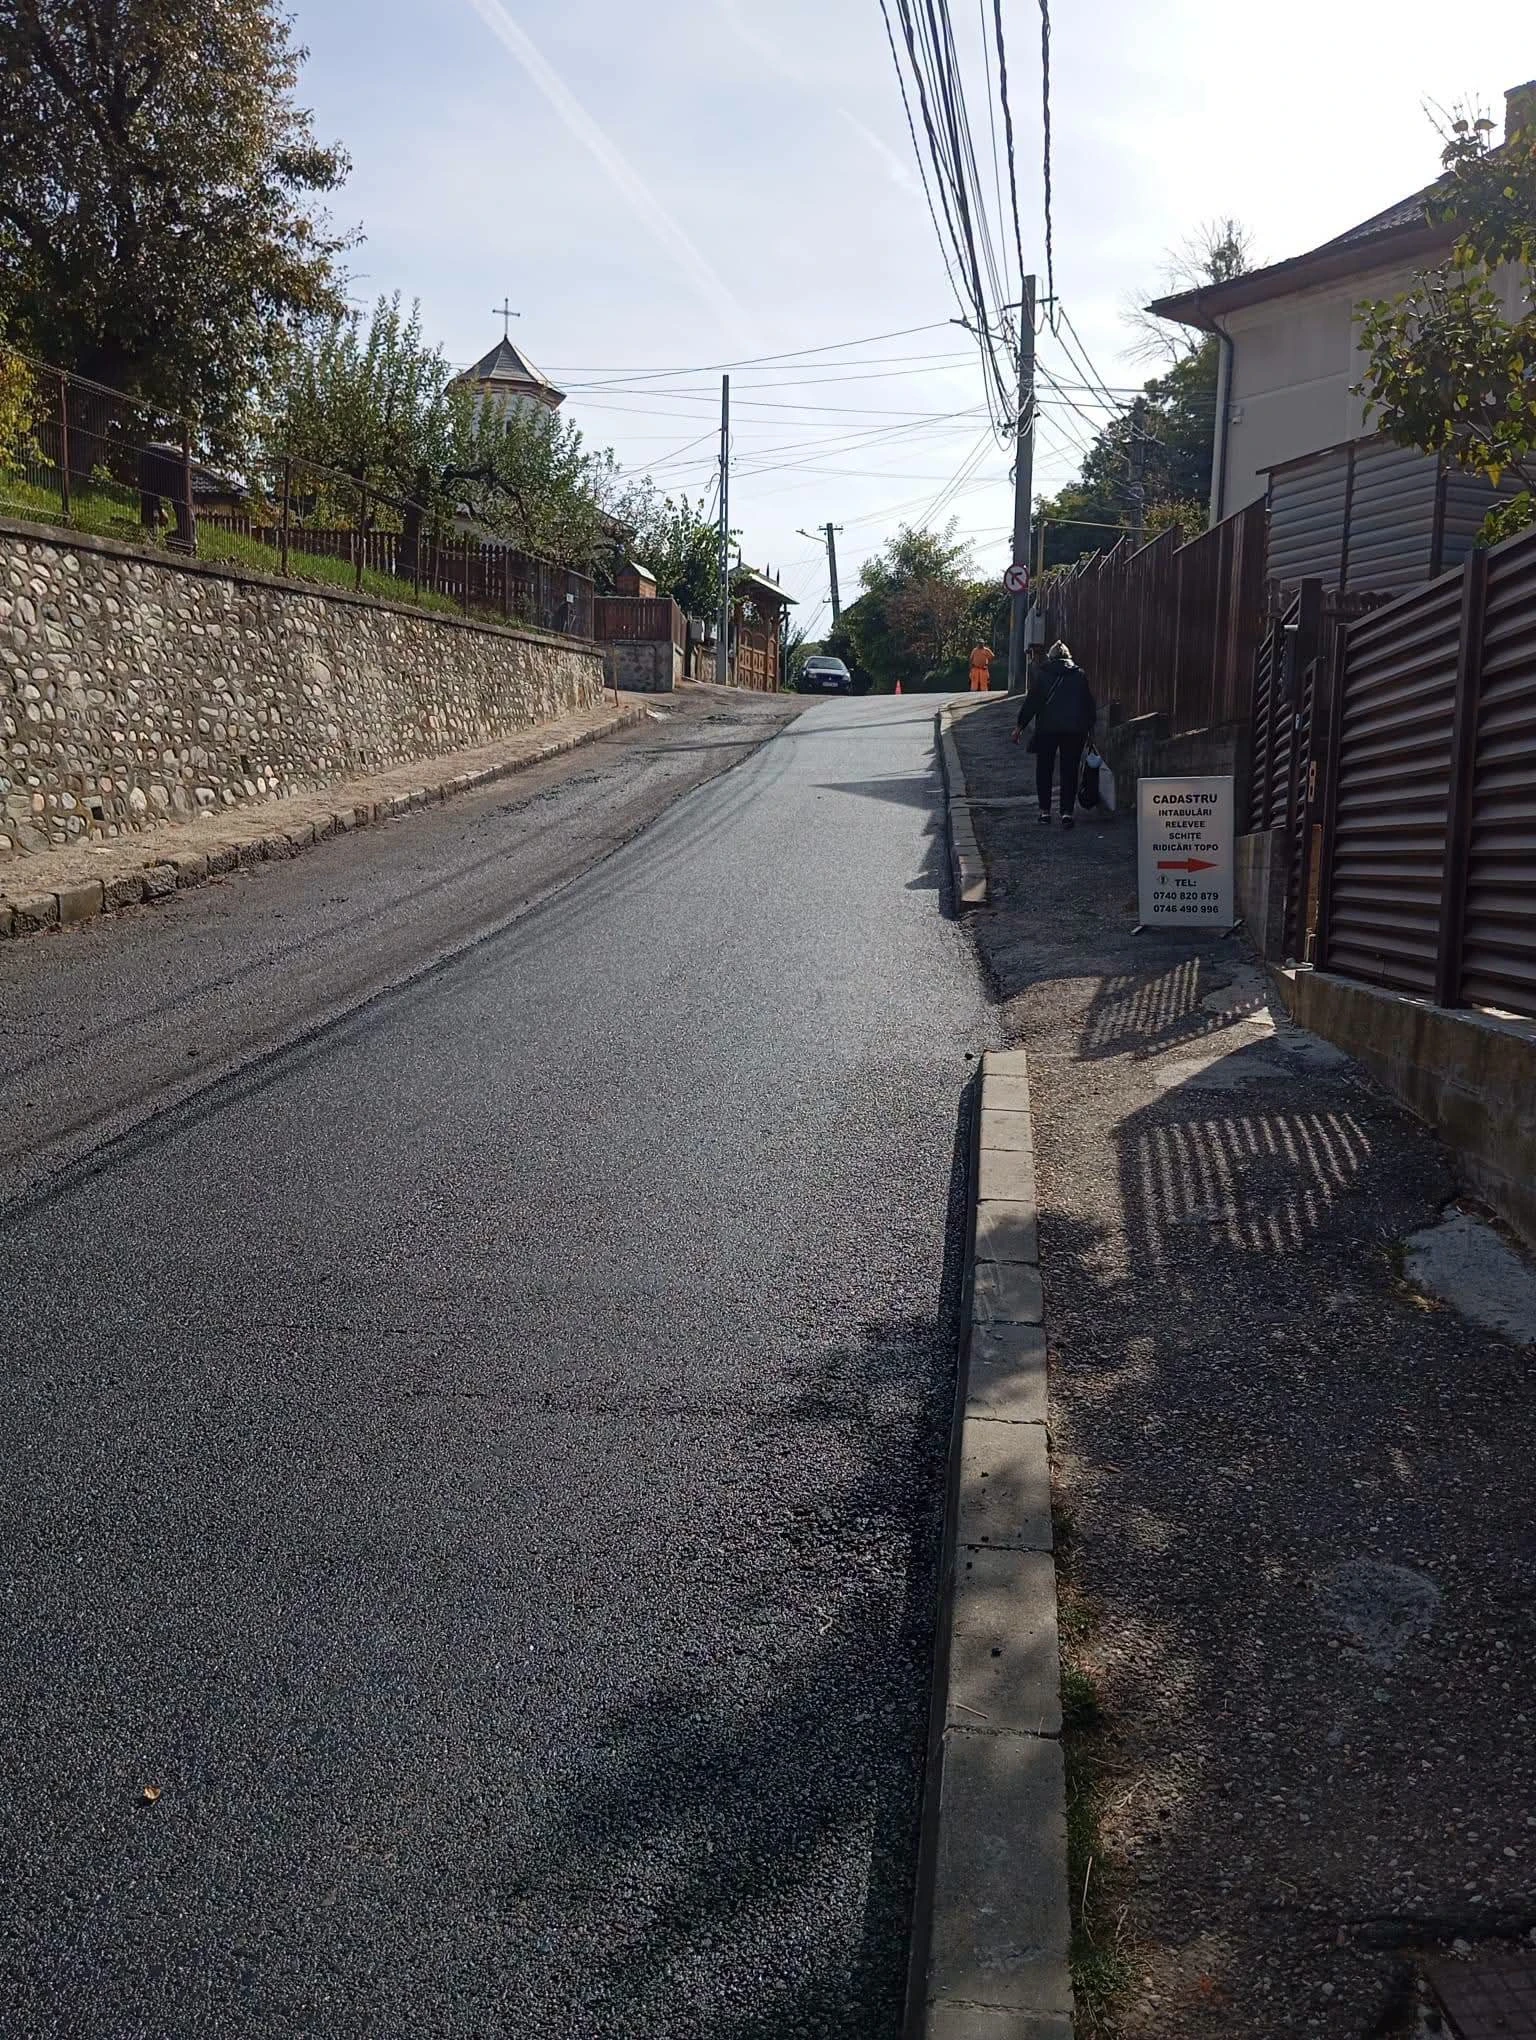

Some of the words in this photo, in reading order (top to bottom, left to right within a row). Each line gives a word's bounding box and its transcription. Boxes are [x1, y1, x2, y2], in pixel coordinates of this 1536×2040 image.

[1153, 794, 1218, 804] CADASTRU
[1165, 820, 1206, 828] RELEVEE
[1175, 879, 1197, 887] TEL:
[1153, 891, 1177, 900] 0740
[1180, 891, 1198, 900] 820
[1200, 892, 1219, 900] 879
